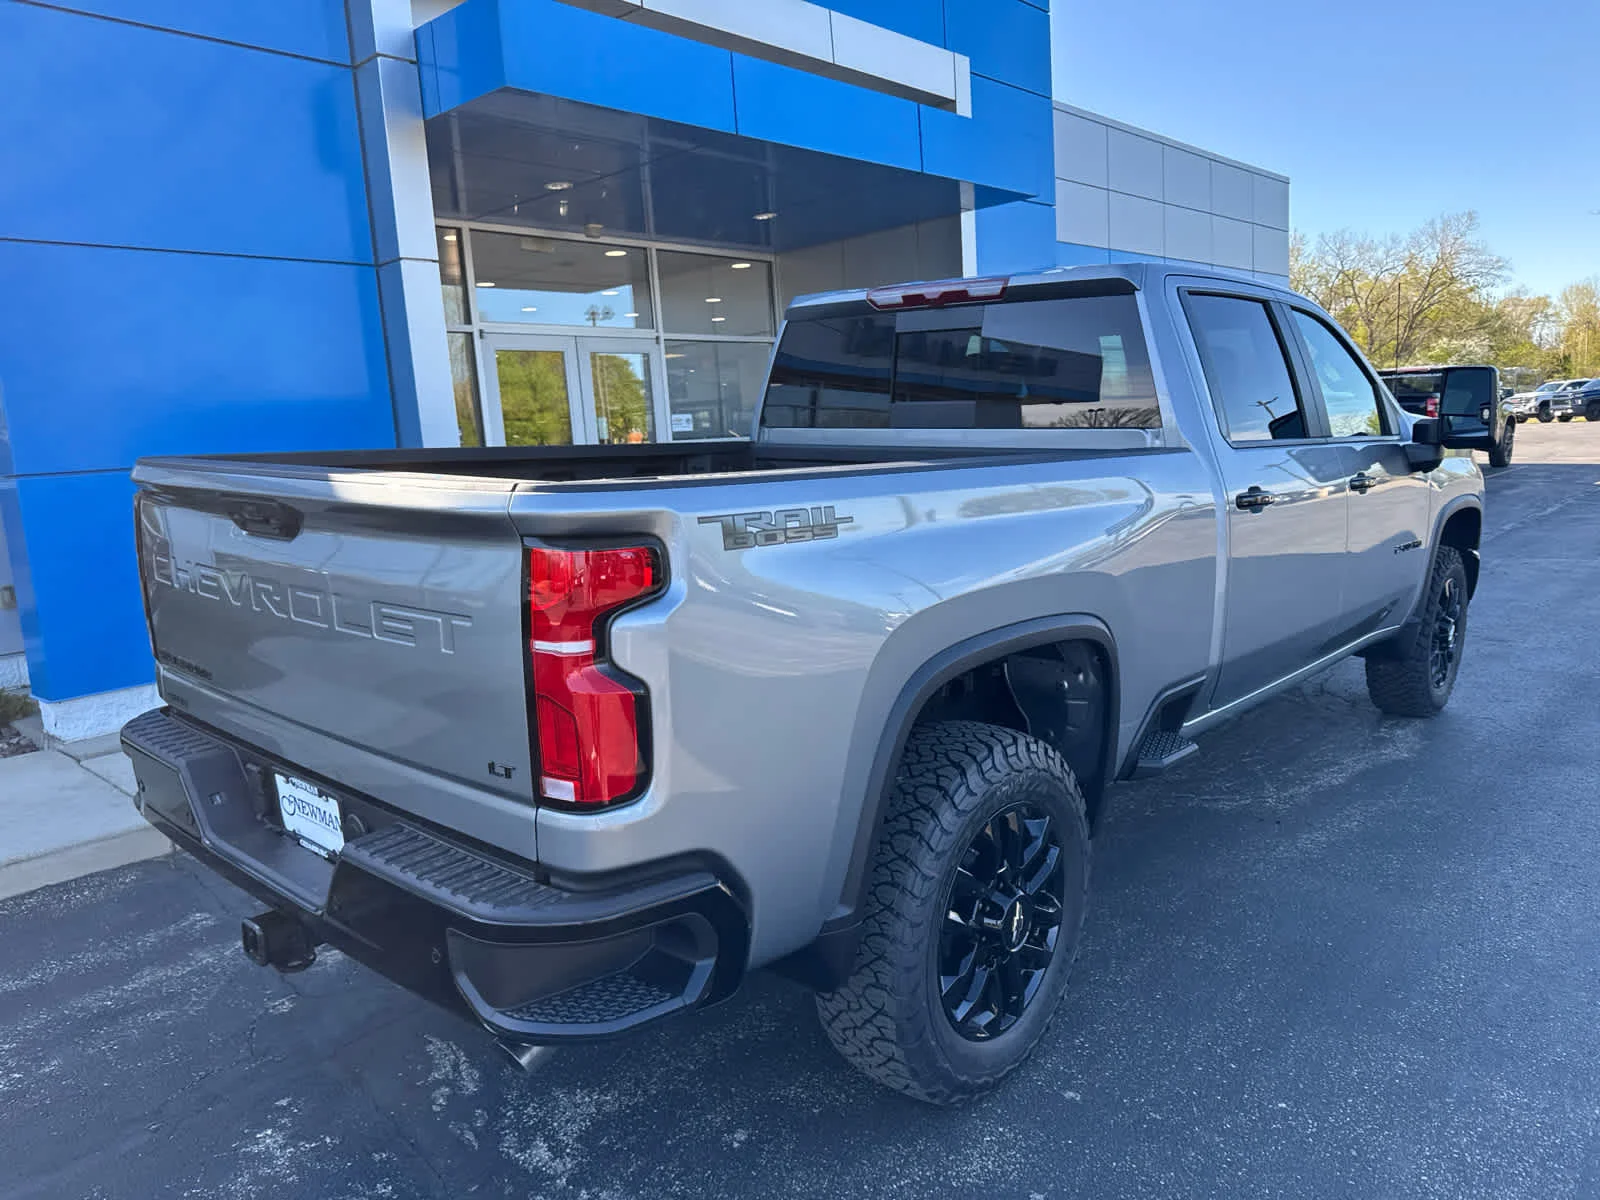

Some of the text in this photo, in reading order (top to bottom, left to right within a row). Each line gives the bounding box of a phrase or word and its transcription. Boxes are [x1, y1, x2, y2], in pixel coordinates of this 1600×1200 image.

[697, 505, 853, 544] TRAIL
[723, 524, 838, 551] BOSS
[152, 550, 473, 654] CHEVROLET
[487, 760, 516, 779] LT
[281, 794, 341, 832] NEWMAN
